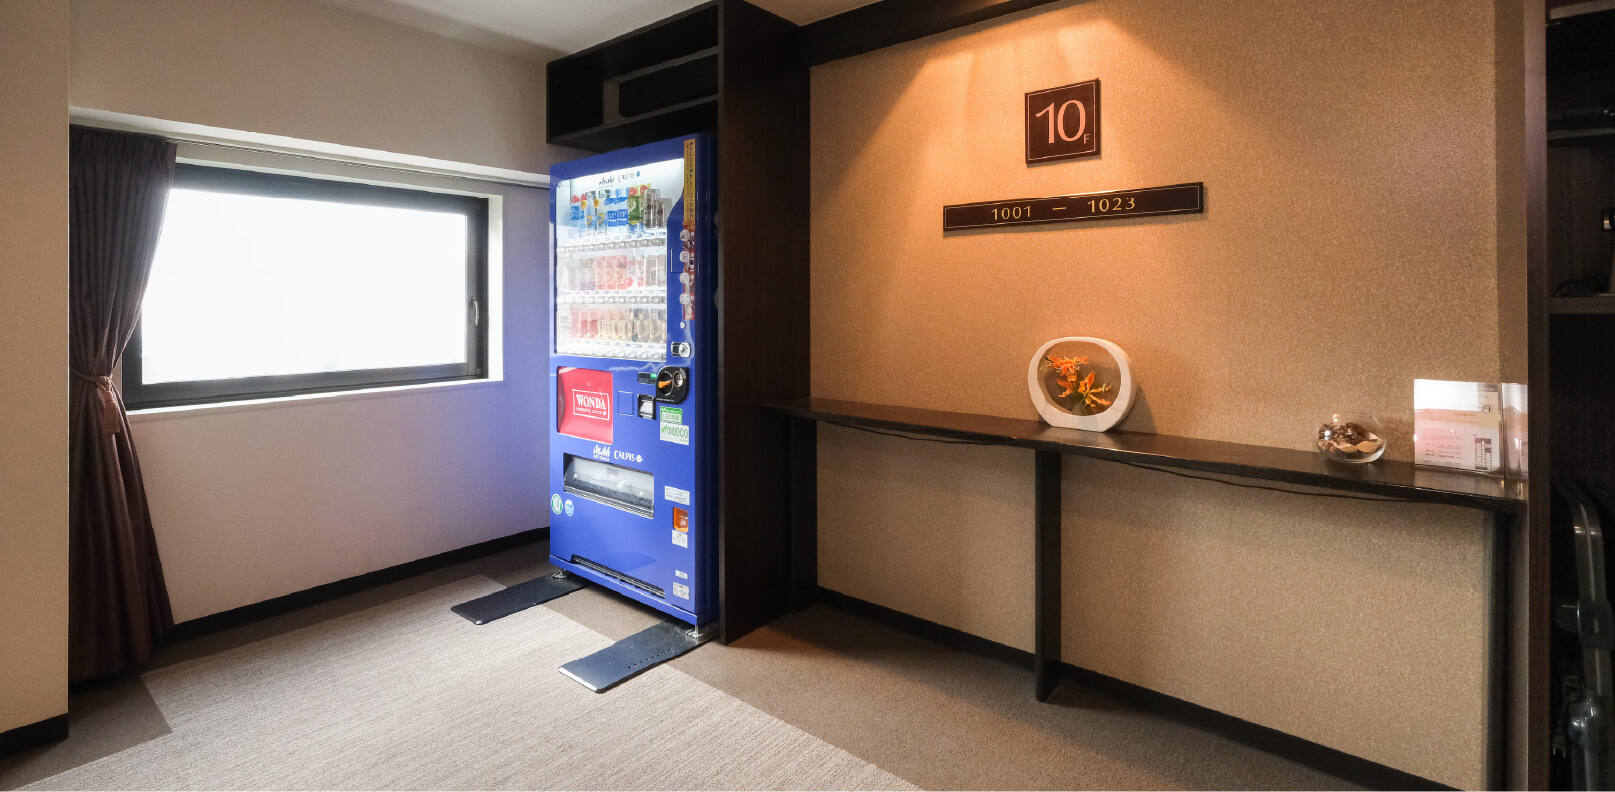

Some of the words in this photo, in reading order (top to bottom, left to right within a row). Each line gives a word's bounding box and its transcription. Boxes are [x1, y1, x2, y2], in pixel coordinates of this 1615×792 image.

[991, 205, 1031, 221] 1001
[1087, 197, 1136, 213] 1023
[575, 393, 607, 411] WONDA
[592, 443, 611, 458] Asahi
[613, 450, 635, 462] CALPIS
